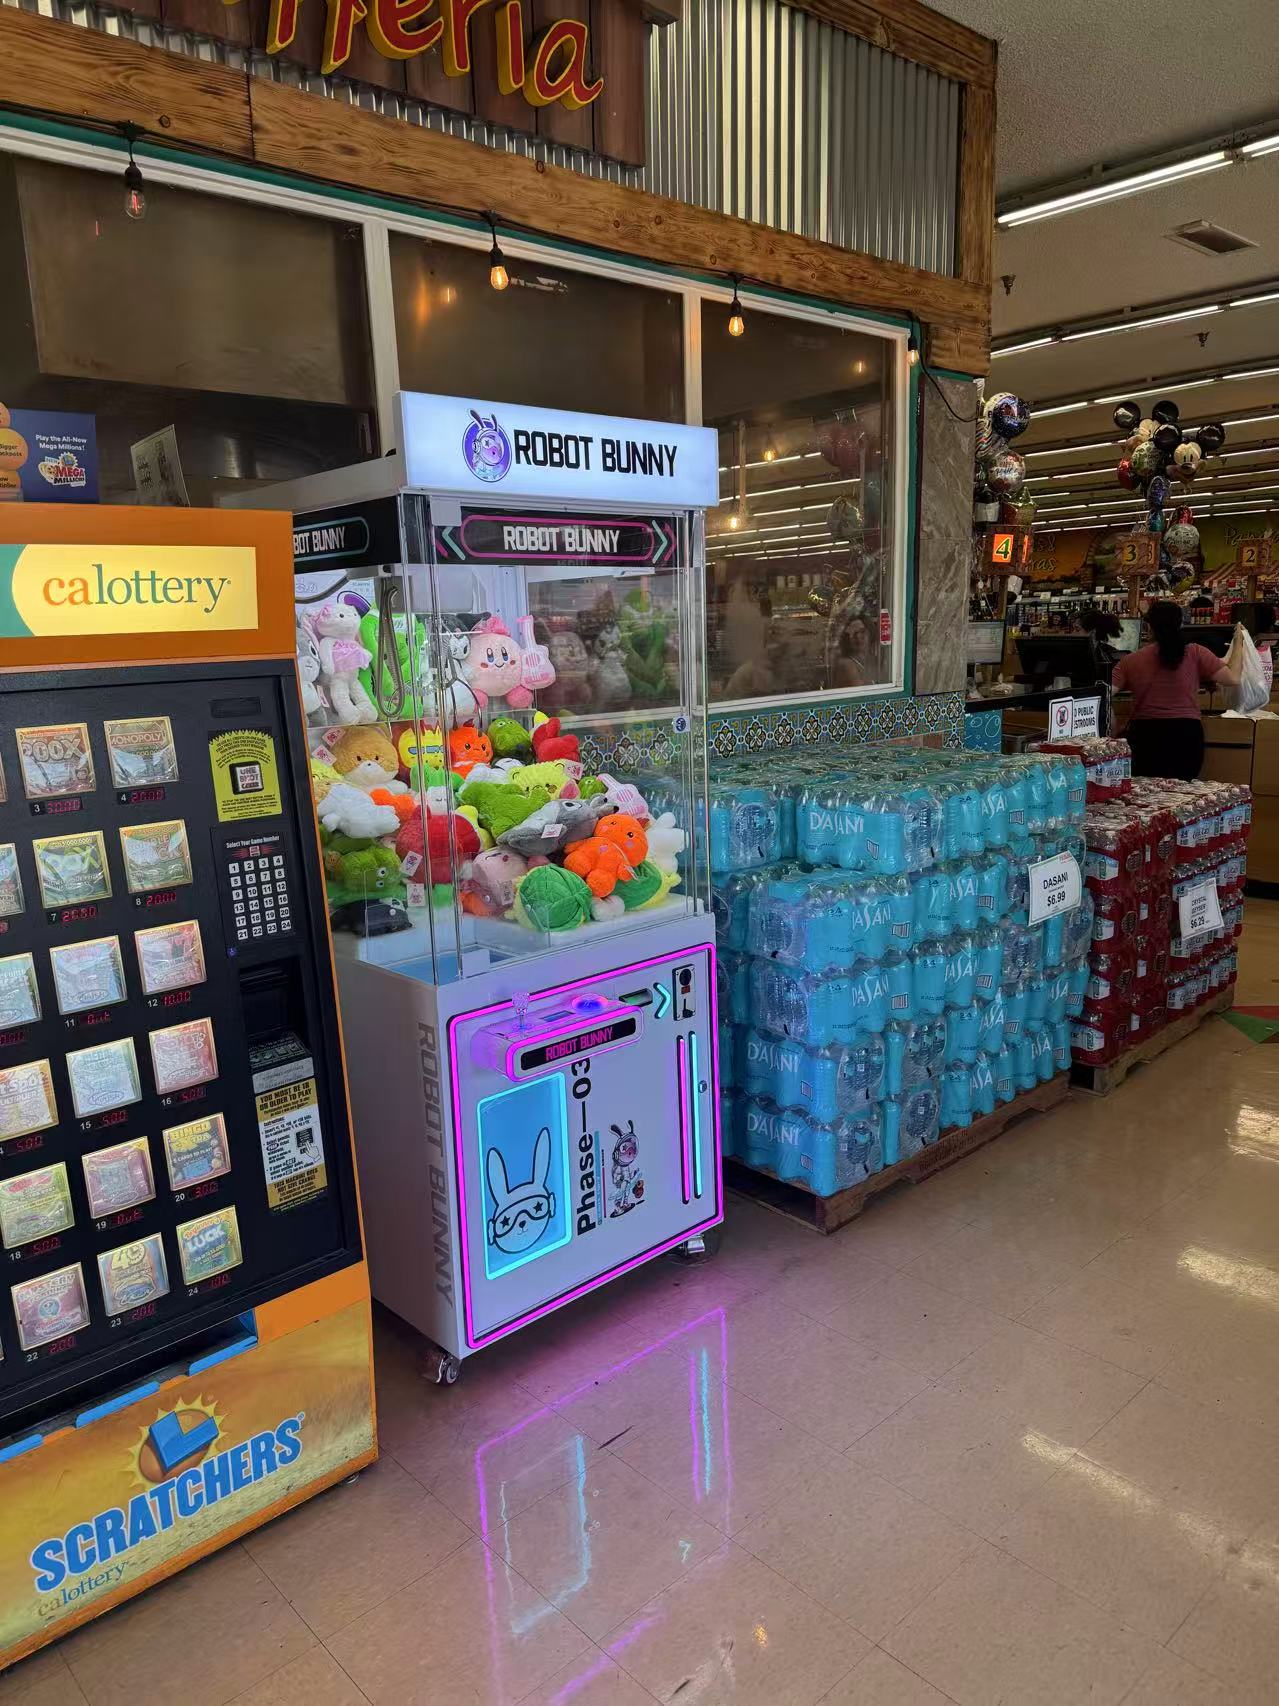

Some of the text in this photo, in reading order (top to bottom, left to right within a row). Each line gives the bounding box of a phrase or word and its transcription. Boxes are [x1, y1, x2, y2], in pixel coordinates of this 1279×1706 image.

[35, 434, 49, 443] Play
[39, 442, 57, 450] Mega
[513, 428, 678, 478] ROBOT BUNNY
[55, 466, 85, 477] MEGA
[293, 525, 347, 555] BOT BUNNY
[502, 524, 620, 554] ROBOT BUNNY
[995, 537, 1011, 560] 4
[1126, 544, 1137, 562] 3
[1245, 549, 1255, 563] 2
[42, 563, 228, 614] calottery
[1077, 705, 1094, 717] PUBLIC
[120, 793, 127, 802] 4
[34, 804, 41, 813] 3
[981, 791, 1008, 819] ASA
[809, 811, 865, 836] DASANI
[226, 841, 240, 849] Select
[263, 835, 280, 843] Number
[1042, 871, 1069, 890] DASANI
[135, 897, 142, 906] 8
[235, 891, 240, 899] 9
[1046, 890, 1066, 907] $6.99
[51, 913, 57, 921] 7
[1190, 915, 1205, 929] $6.29
[282, 921, 291, 929] 24
[147, 998, 158, 1008] 12
[64, 1019, 75, 1028] 11
[545, 1026, 614, 1062] ROBOT BUNNY
[746, 1041, 800, 1073] DASANI
[259, 1103, 269, 1111] OR
[269, 1096, 288, 1108] OLDER
[289, 1094, 297, 1102] TO
[298, 1088, 312, 1098] PLAY
[260, 1094, 273, 1104] YOU
[273, 1088, 292, 1099] MUST
[293, 1085, 301, 1093] BE
[161, 1098, 172, 1107] 16
[80, 1121, 92, 1131] 15
[746, 1112, 800, 1146] DASANI
[417, 1021, 454, 1309] ROBOT BUNNY
[174, 1193, 185, 1203] 20
[95, 1220, 107, 1231] 19
[185, 1225, 225, 1253] LUCK
[10, 1251, 21, 1261] 18
[188, 1287, 199, 1297] 24
[110, 1318, 122, 1328] 23
[27, 1352, 39, 1362] 22
[30, 1418, 304, 1594] SCRATCHERS
[36, 1558, 129, 1617] calottery
